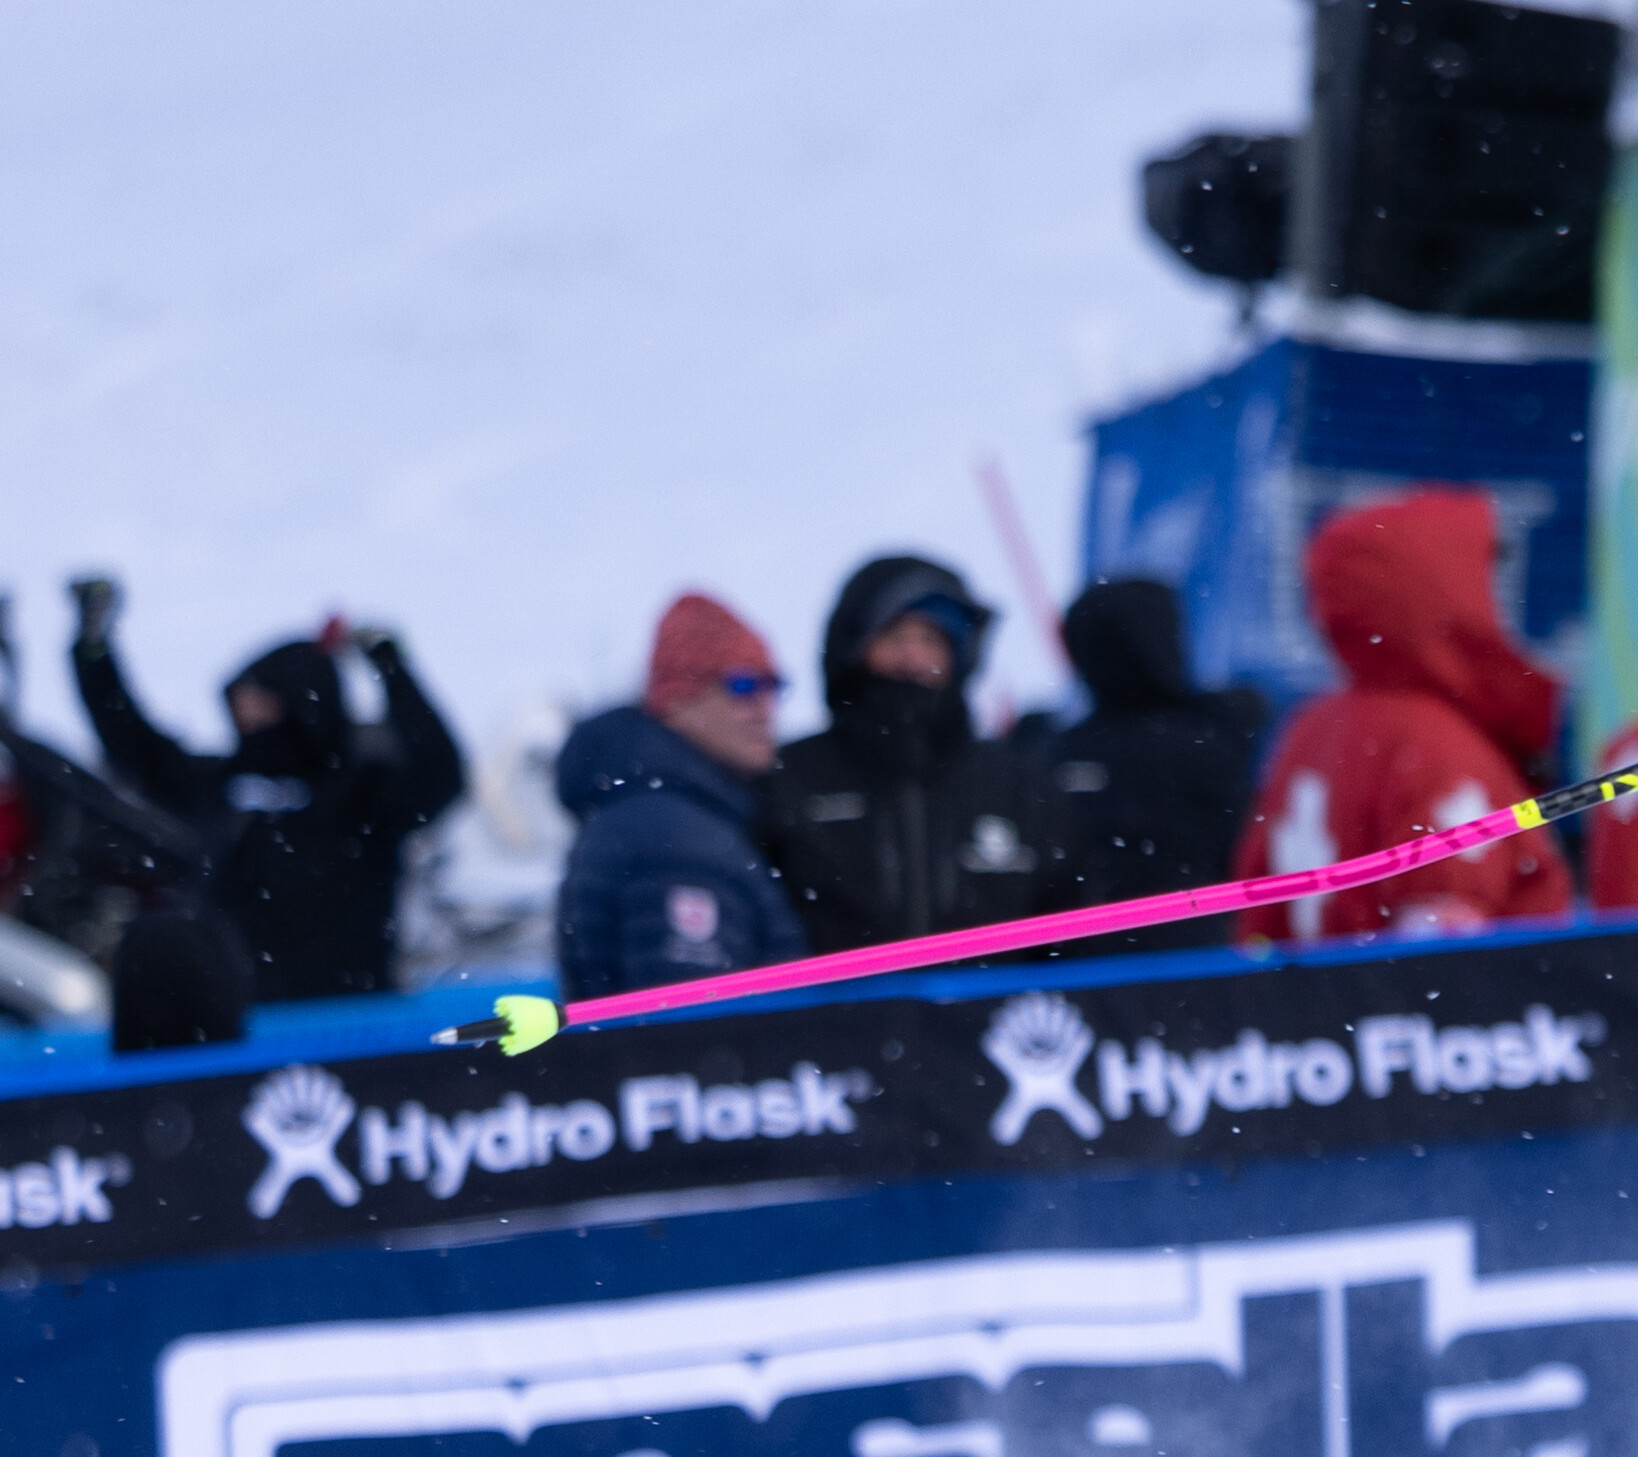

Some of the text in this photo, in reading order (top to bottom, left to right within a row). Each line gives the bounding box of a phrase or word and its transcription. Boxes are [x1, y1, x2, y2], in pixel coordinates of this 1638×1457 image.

[363, 1067, 859, 1199] Hydro Flask
[1098, 1010, 1592, 1133] Hydro Flask
